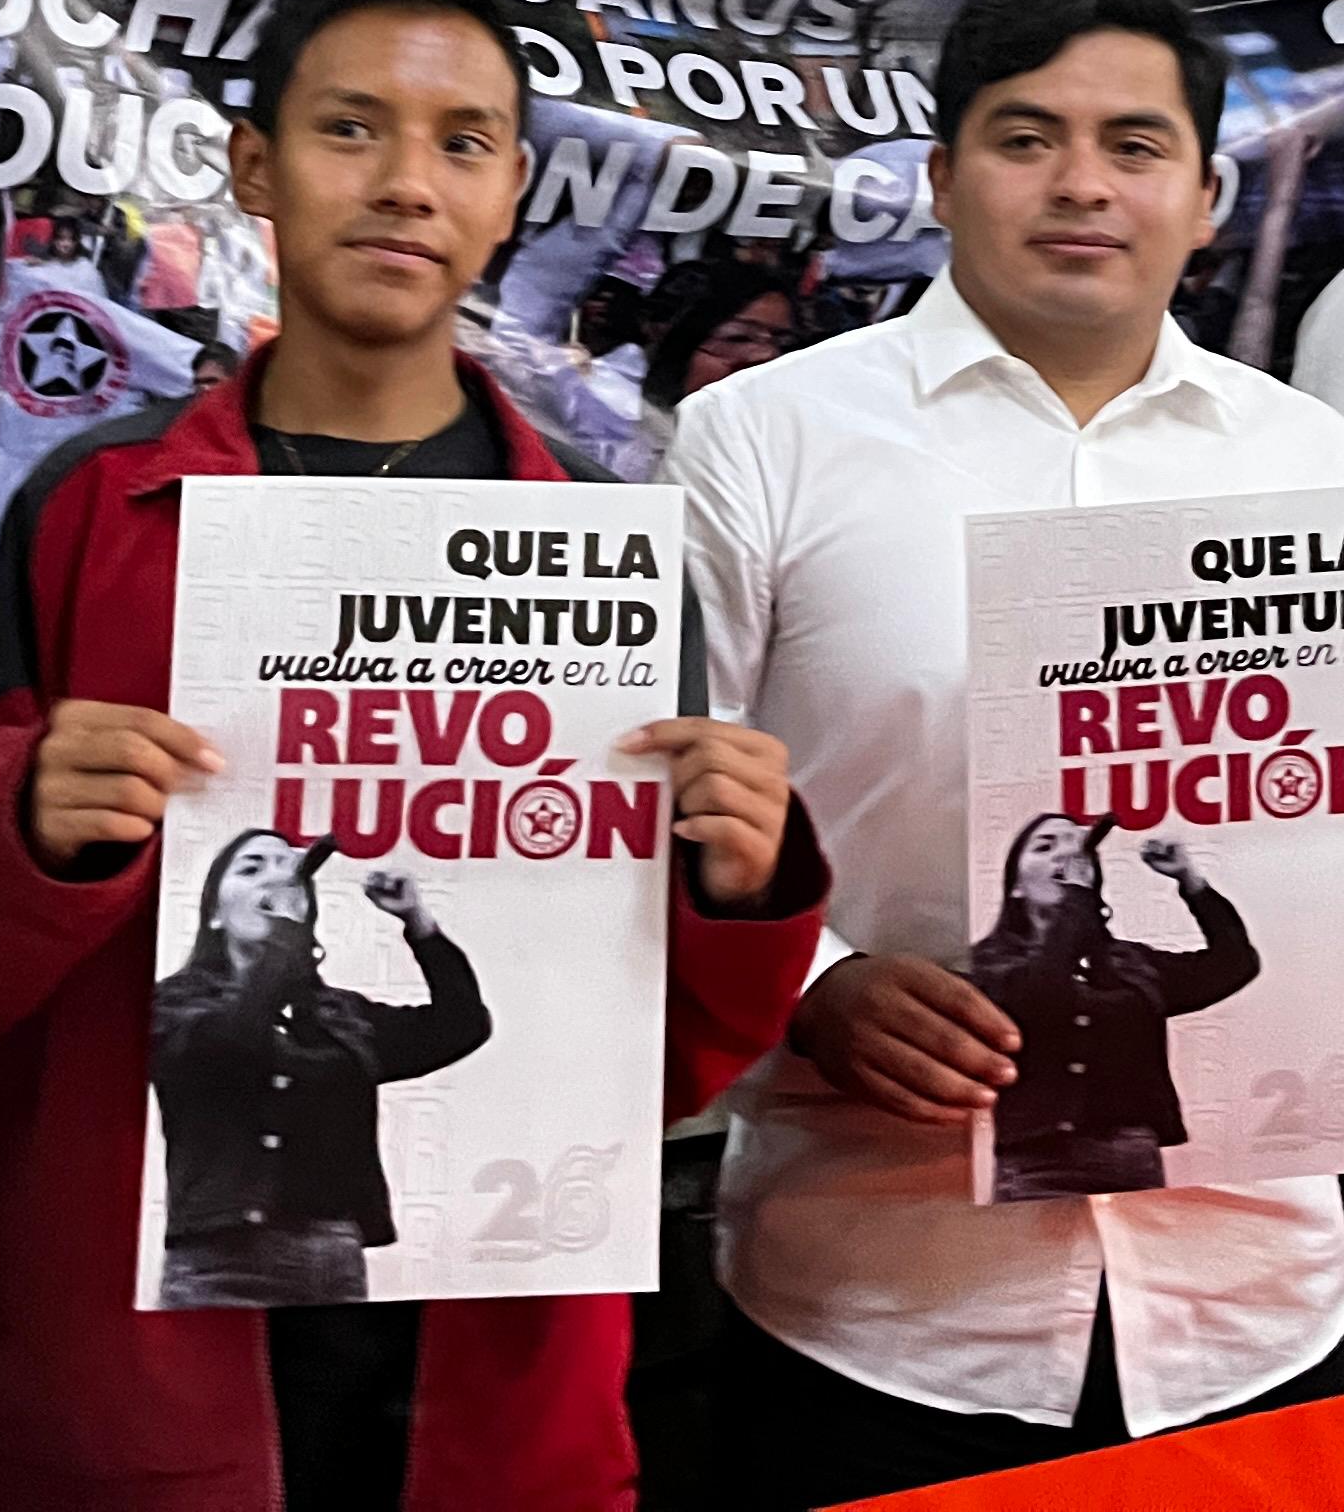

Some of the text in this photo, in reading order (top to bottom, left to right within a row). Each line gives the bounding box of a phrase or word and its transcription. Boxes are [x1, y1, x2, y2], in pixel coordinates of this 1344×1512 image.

[595, 41, 820, 131] POR
[639, 143, 809, 239] DE
[446, 528, 660, 580] QUE LA
[1191, 534, 1297, 583] QUE
[336, 593, 658, 658] JUVENTUD
[258, 646, 657, 687] vuelva a creer en la
[1039, 653, 1157, 688] vuelva
[1163, 655, 1189, 678] a
[1196, 645, 1290, 676] creer
[1296, 642, 1339, 668] en
[276, 689, 553, 767] REVO
[1057, 674, 1290, 757] REVO
[273, 758, 661, 861] LUCIÓN
